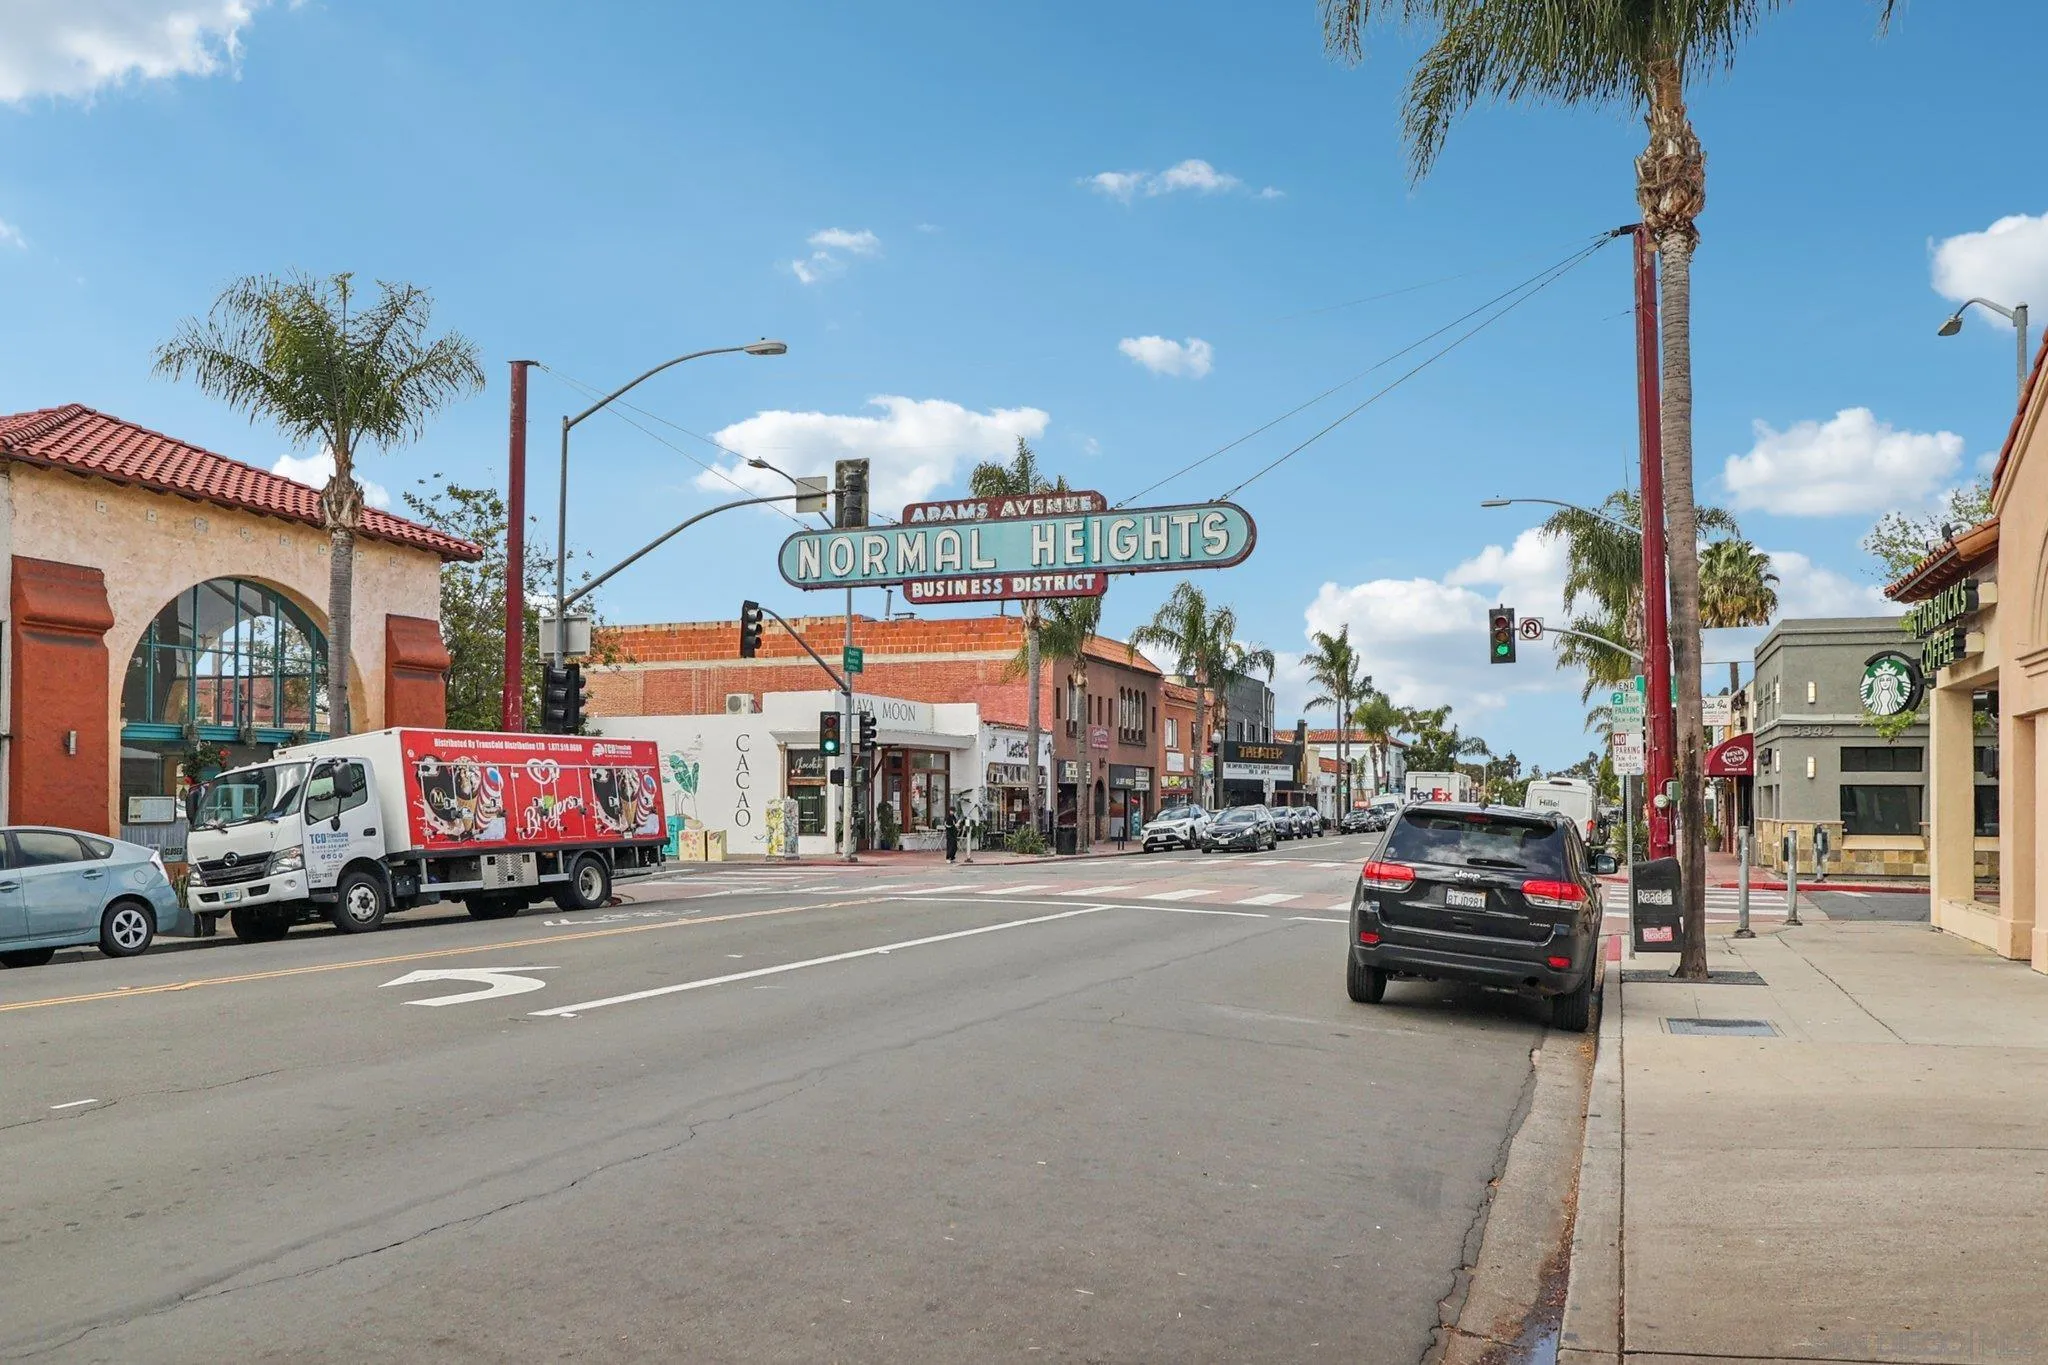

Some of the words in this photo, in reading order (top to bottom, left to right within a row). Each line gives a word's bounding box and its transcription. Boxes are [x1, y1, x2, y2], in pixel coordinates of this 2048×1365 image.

[909, 502, 988, 524] ADAMS
[1000, 494, 1095, 518] AVENUE
[797, 527, 997, 579] NORMAL
[1030, 510, 1230, 568] HEIGHTS
[911, 576, 1004, 599] BUSINESS
[1012, 573, 1096, 594] DISTRICT
[1913, 578, 1967, 640] STARBUCKS
[1921, 628, 1955, 678] COFFEE
[1618, 682, 1635, 690] END
[1614, 693, 1621, 703] 2
[882, 701, 916, 721] MOON
[1614, 706, 1640, 715] PARKING
[1791, 725, 1834, 737] 3342
[1614, 734, 1626, 745] NO
[1239, 745, 1284, 759] THEATER
[1615, 747, 1640, 755] PARKING
[734, 733, 751, 828] CACAO
[1409, 787, 1452, 802] FedEx
[309, 832, 327, 845] TCD
[164, 847, 183, 856] CLOSED
[1454, 869, 1481, 882] Jeep
[1643, 929, 1672, 940] Reader
